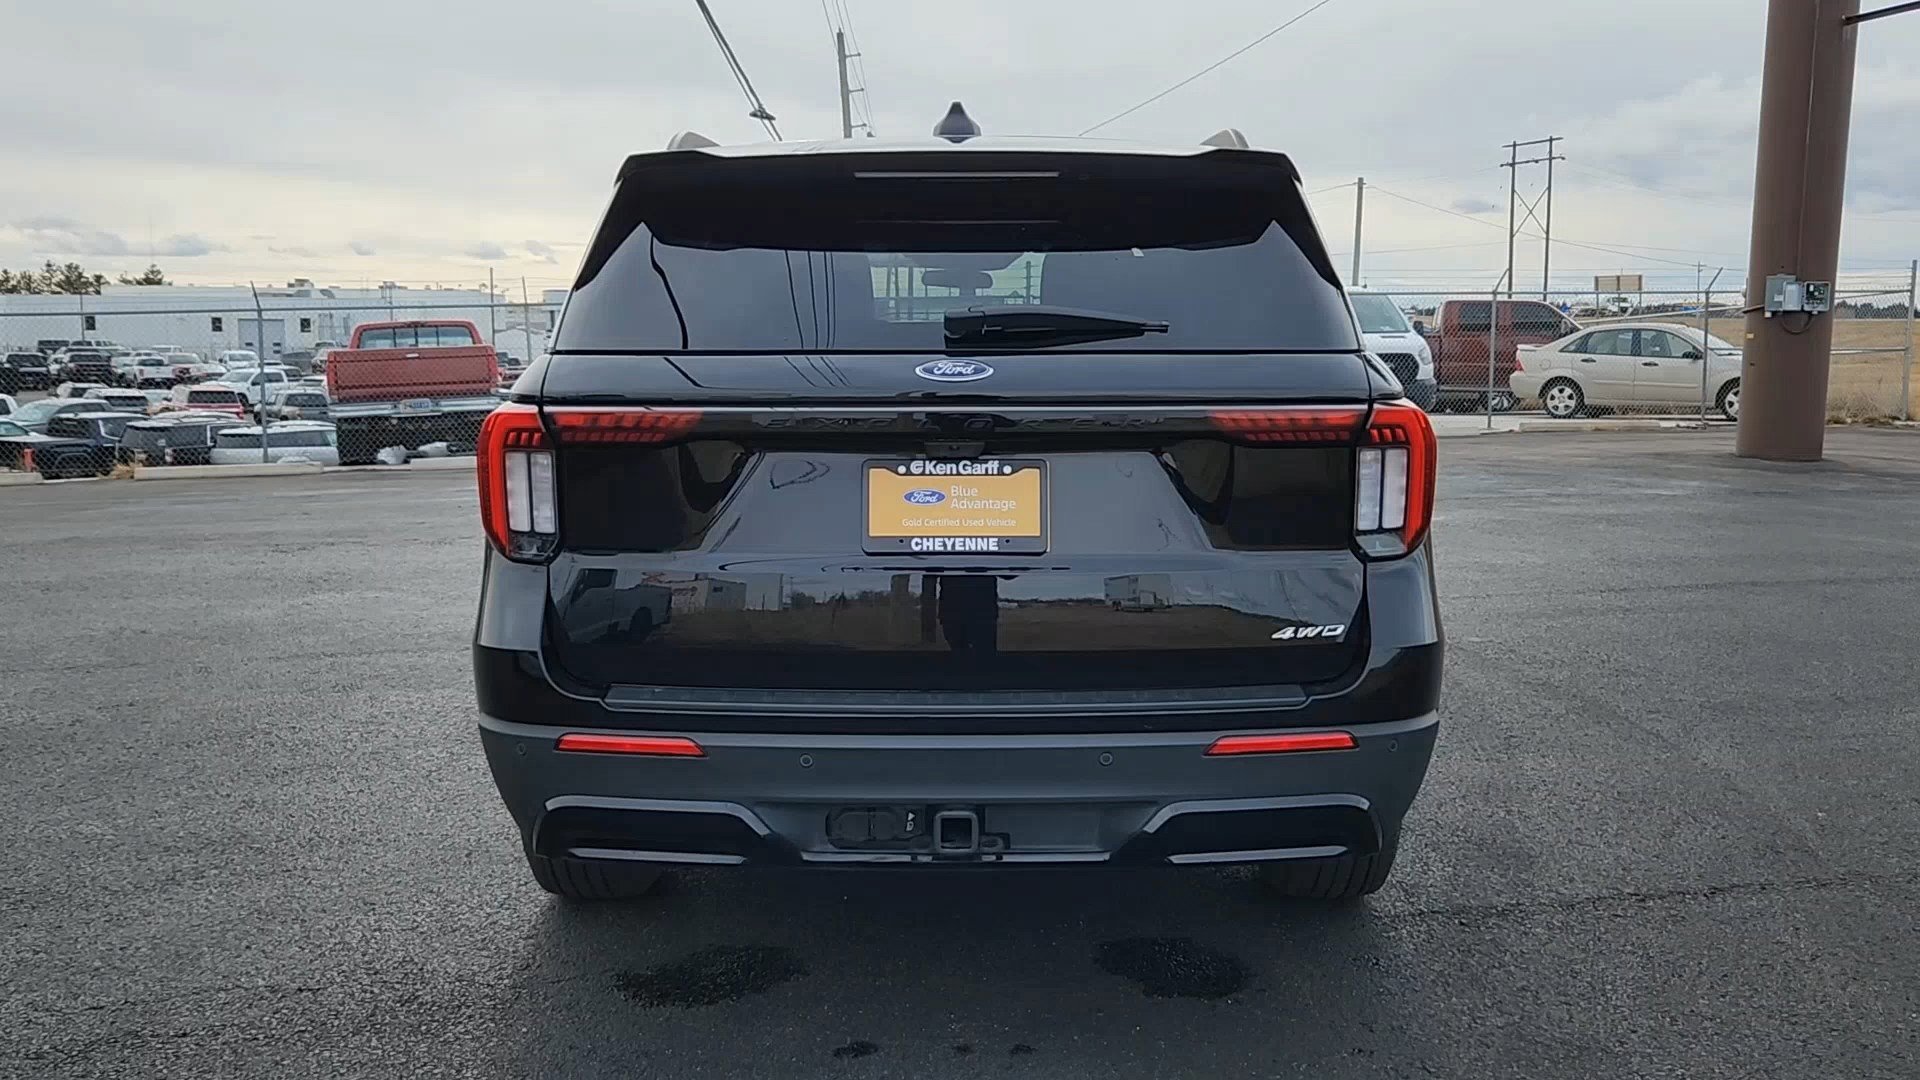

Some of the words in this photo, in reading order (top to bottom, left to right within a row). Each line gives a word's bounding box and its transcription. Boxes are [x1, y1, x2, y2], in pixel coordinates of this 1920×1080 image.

[933, 362, 975, 375] Ford
[958, 460, 1000, 475] Garff
[910, 490, 939, 504] Ford
[951, 485, 978, 497] Blue
[950, 499, 1016, 512] Advantage
[902, 518, 922, 527] Gold
[924, 518, 960, 527] Certified
[962, 518, 984, 527] Used
[986, 518, 1016, 527] Vehicle
[911, 538, 999, 551] CHEYENNE
[1271, 624, 1345, 640] 4WD
